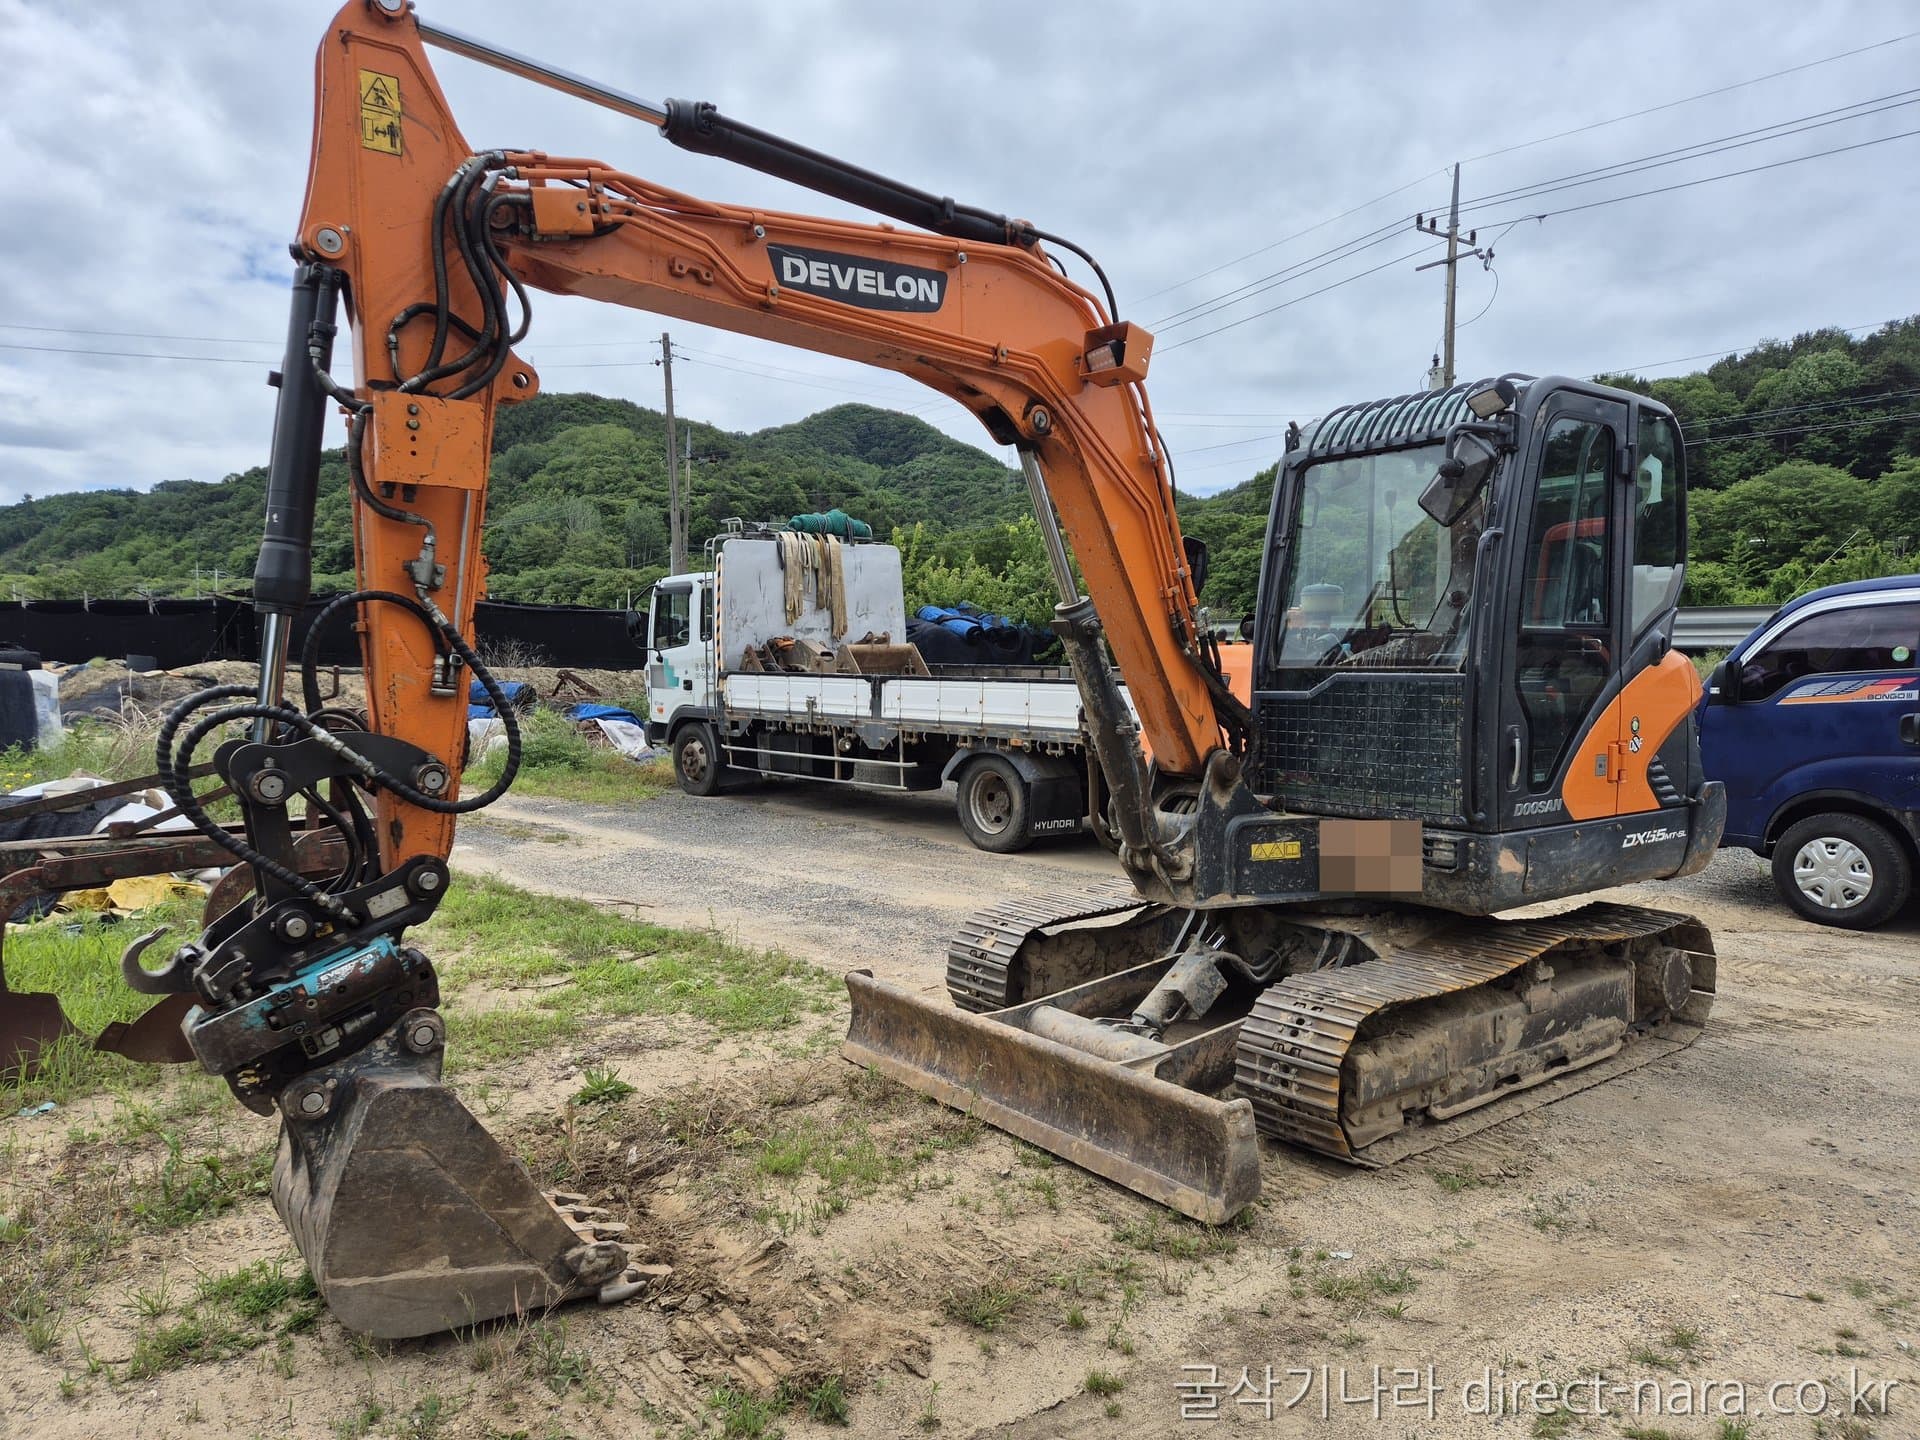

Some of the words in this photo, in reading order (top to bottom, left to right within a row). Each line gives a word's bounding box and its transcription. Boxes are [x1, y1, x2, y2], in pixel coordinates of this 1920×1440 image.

[782, 256, 939, 303] DEVELON
[1867, 692, 1905, 700] BONGO
[1513, 798, 1562, 816] DOOSAN
[1034, 819, 1075, 830] HYUNDAI
